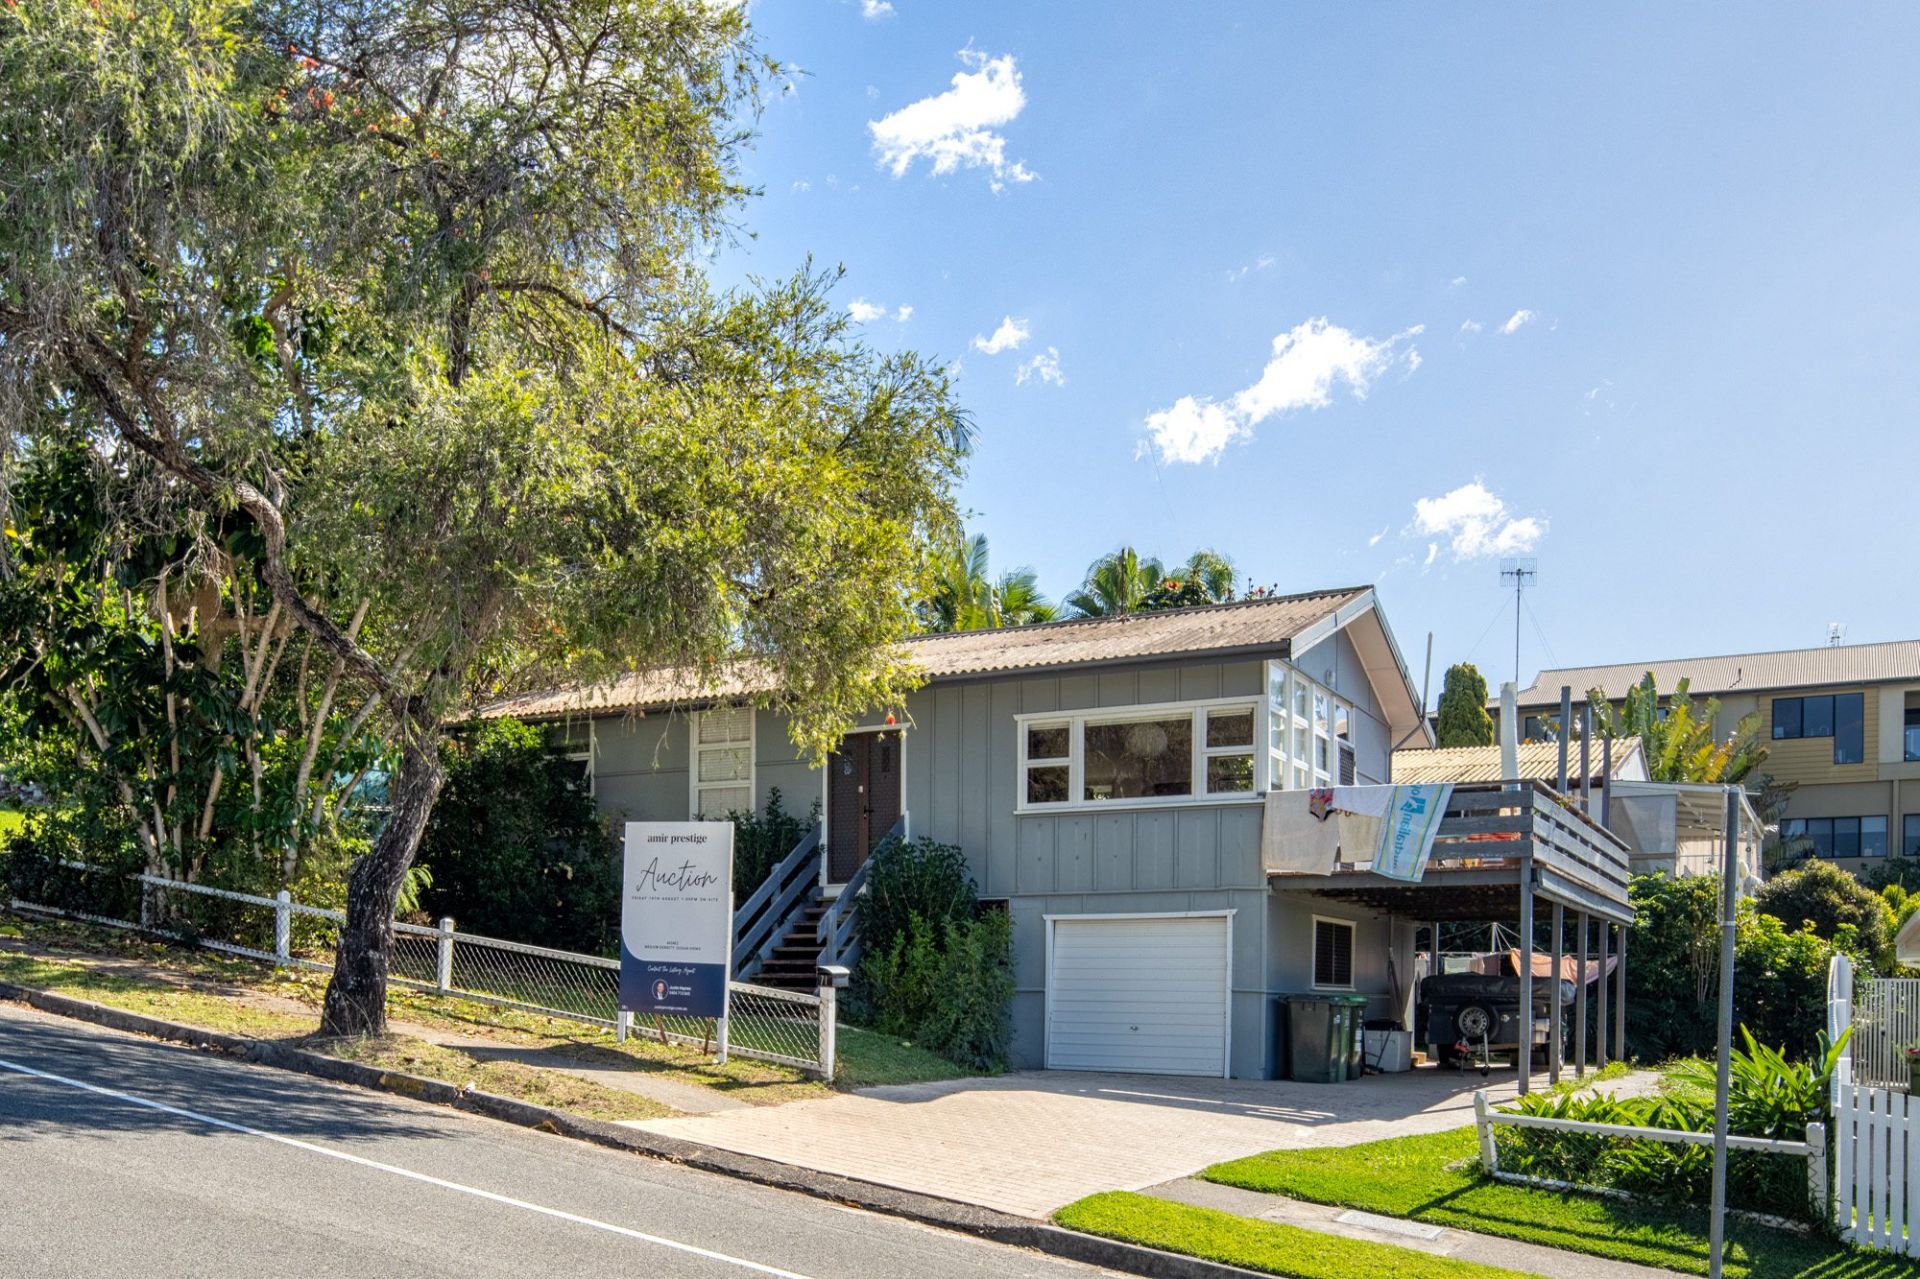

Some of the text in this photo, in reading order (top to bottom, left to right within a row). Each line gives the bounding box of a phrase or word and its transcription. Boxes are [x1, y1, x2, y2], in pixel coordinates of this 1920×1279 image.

[647, 833, 708, 845] amir prestige
[636, 856, 718, 892] Auction
